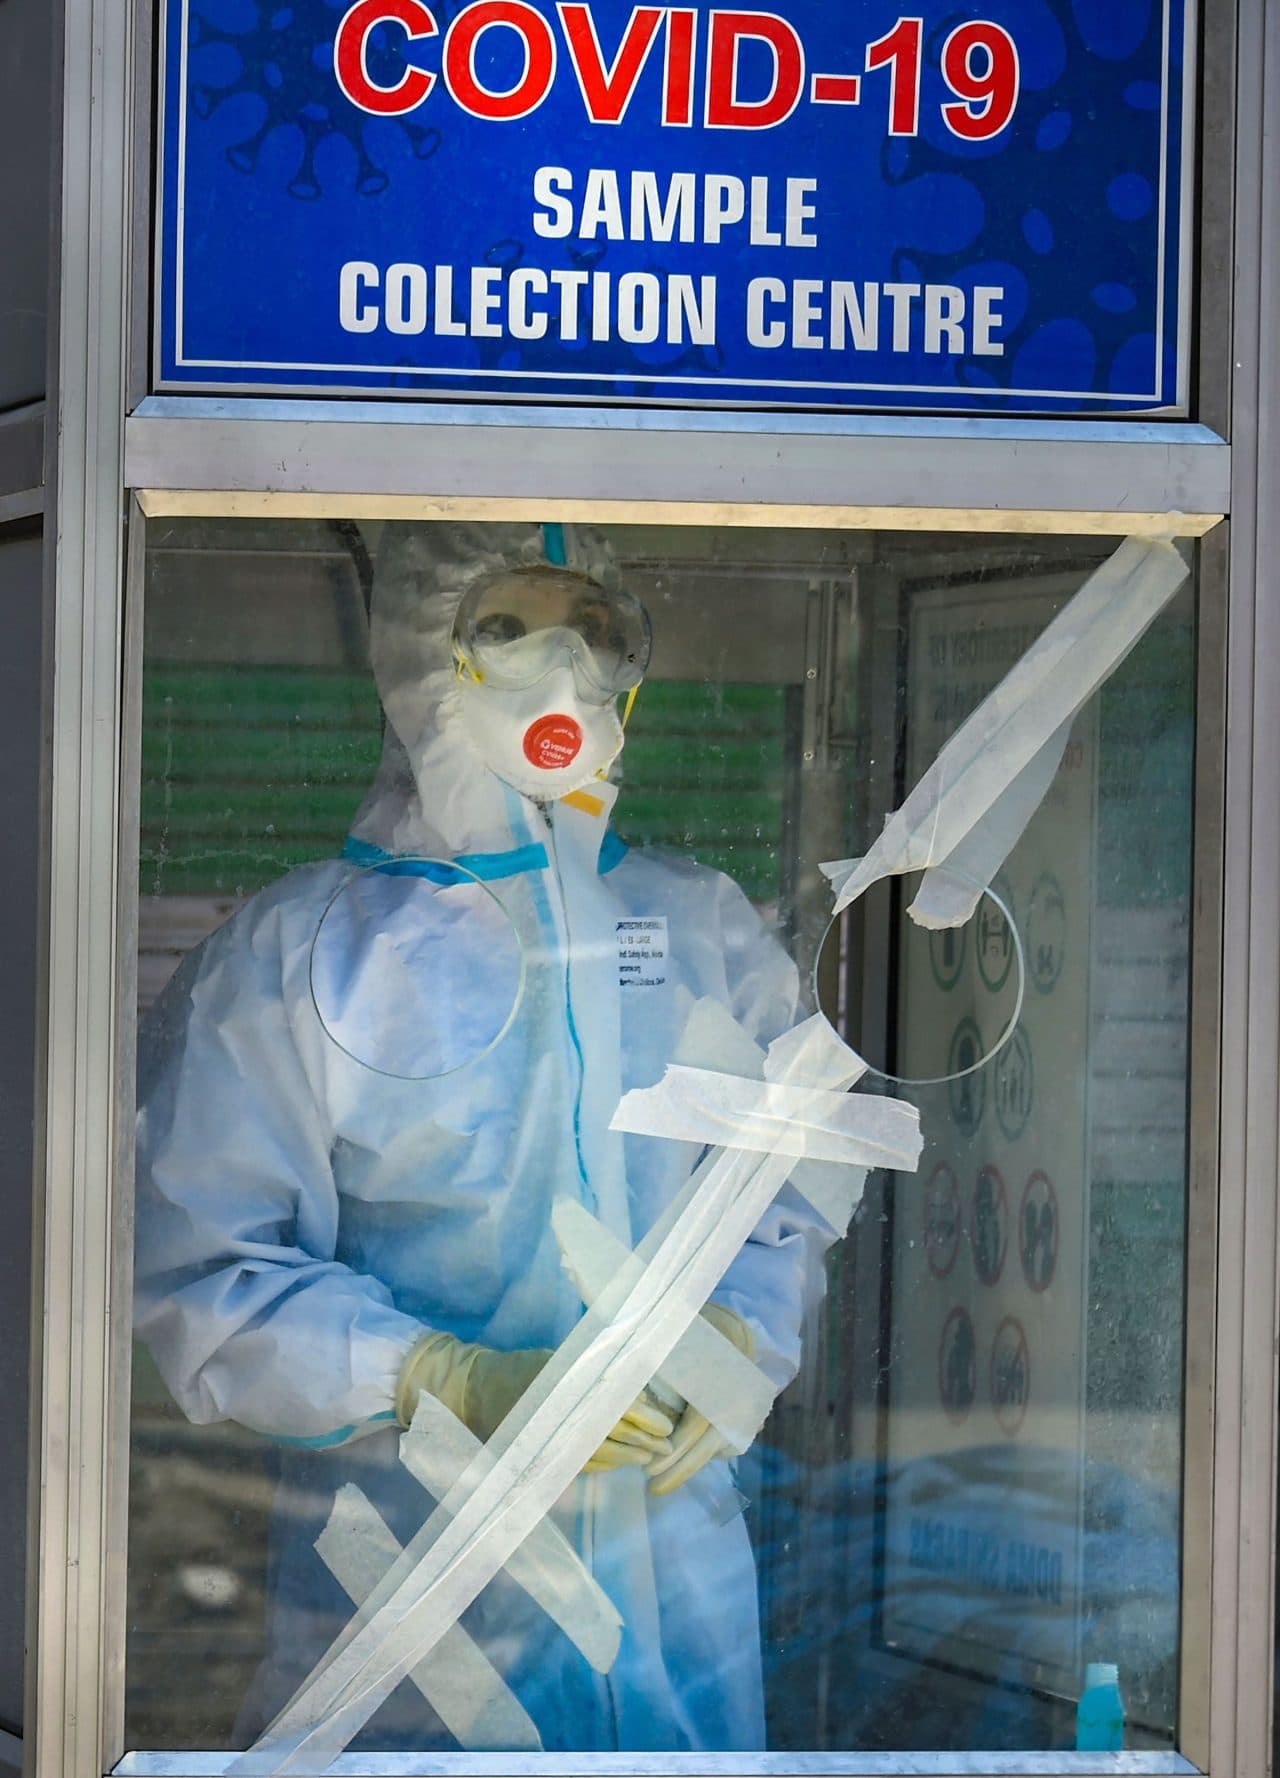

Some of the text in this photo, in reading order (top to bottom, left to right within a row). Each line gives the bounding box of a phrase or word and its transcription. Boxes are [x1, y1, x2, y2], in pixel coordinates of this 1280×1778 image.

[333, 0, 1021, 142] COVID-19
[532, 166, 818, 248] SAMPLE
[339, 261, 1005, 357] COLECTION CENTRE
